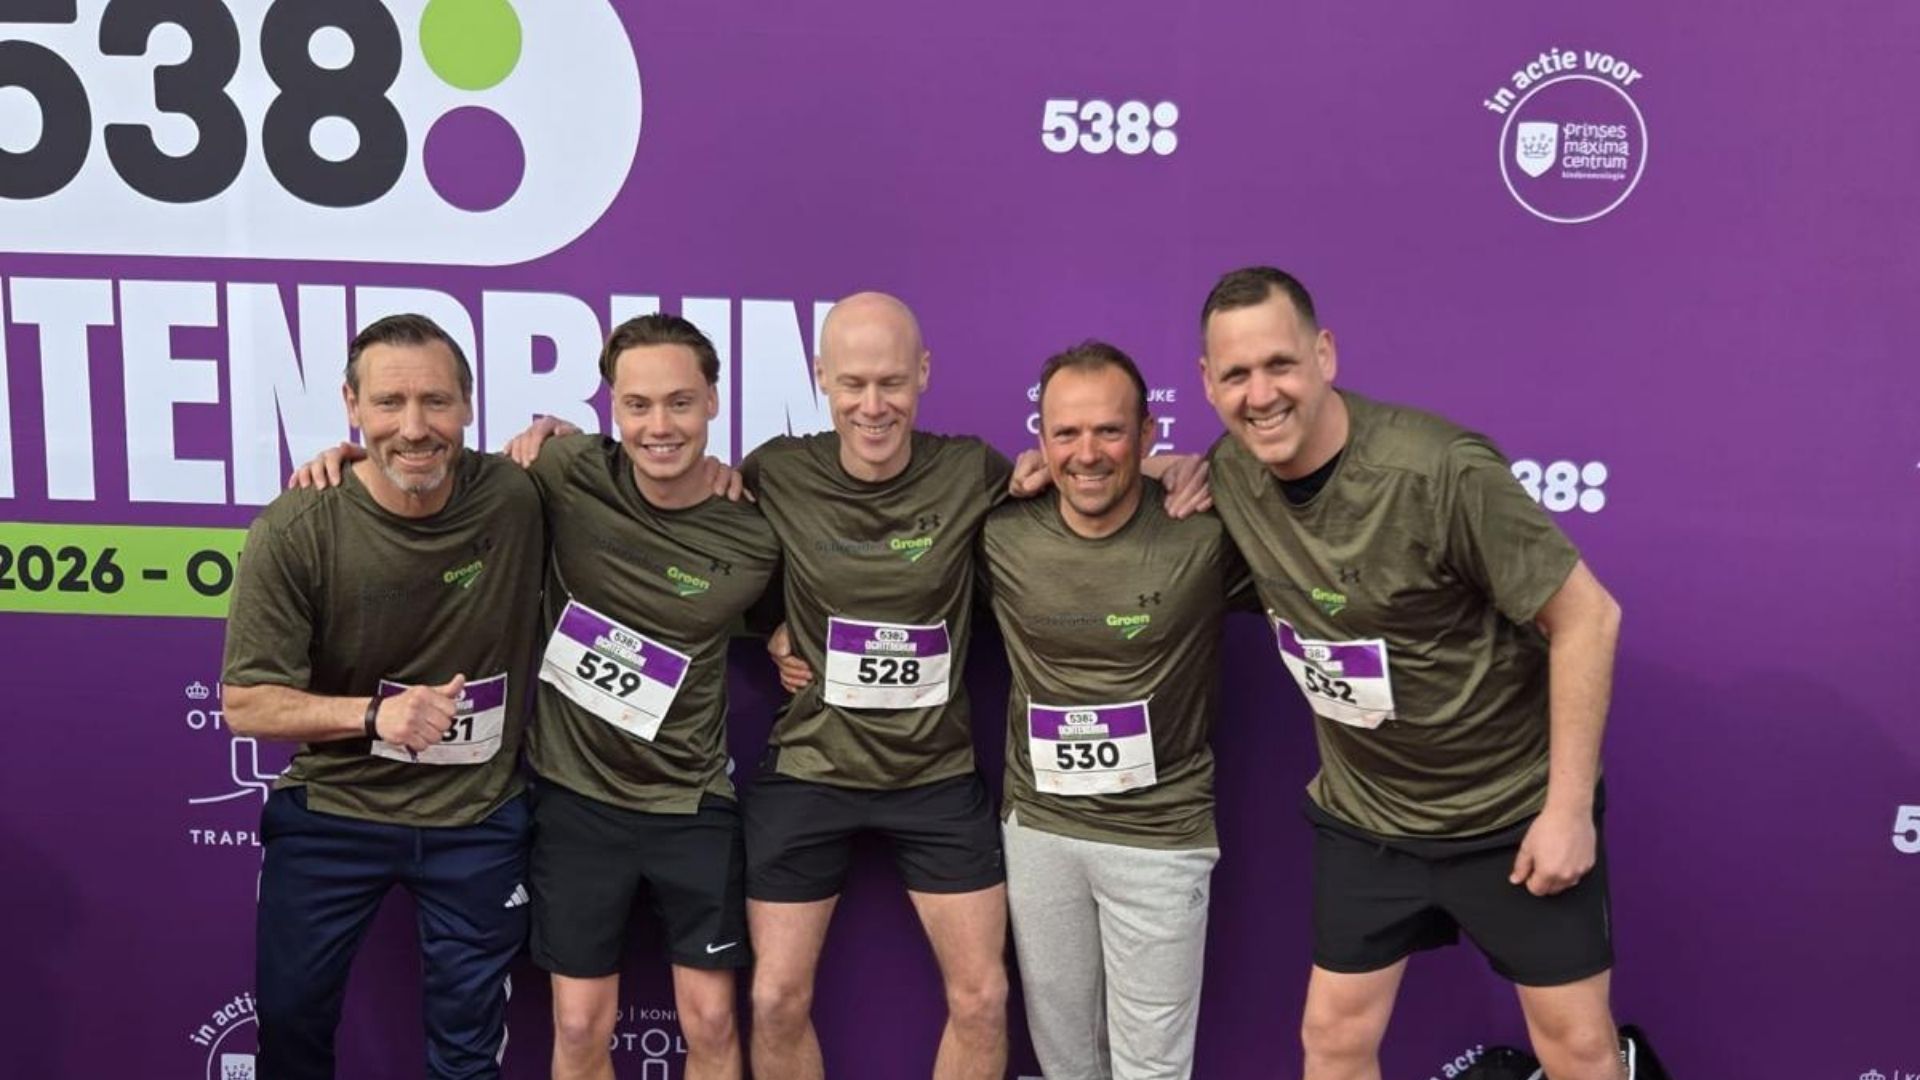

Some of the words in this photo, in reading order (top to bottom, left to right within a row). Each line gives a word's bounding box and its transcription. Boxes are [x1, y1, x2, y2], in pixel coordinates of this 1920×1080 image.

[1483, 87, 1516, 114] in
[1512, 47, 1578, 90] actie
[1584, 50, 1643, 86] voor
[1562, 122, 1627, 140] prinses
[1564, 138, 1630, 155] máxima
[1562, 154, 1627, 170] centrum
[890, 536, 933, 551] Groen
[186, 549, 242, 597] O
[443, 559, 484, 584] Groen
[666, 565, 711, 590] Groen
[1106, 613, 1150, 627] Groen
[575, 650, 642, 698] 529
[857, 657, 920, 685] 528
[1304, 664, 1357, 706] 532
[1056, 741, 1120, 770] 530
[189, 829, 262, 847] TRAPL
[189, 1024, 216, 1046] in
[212, 992, 257, 1026] acti
